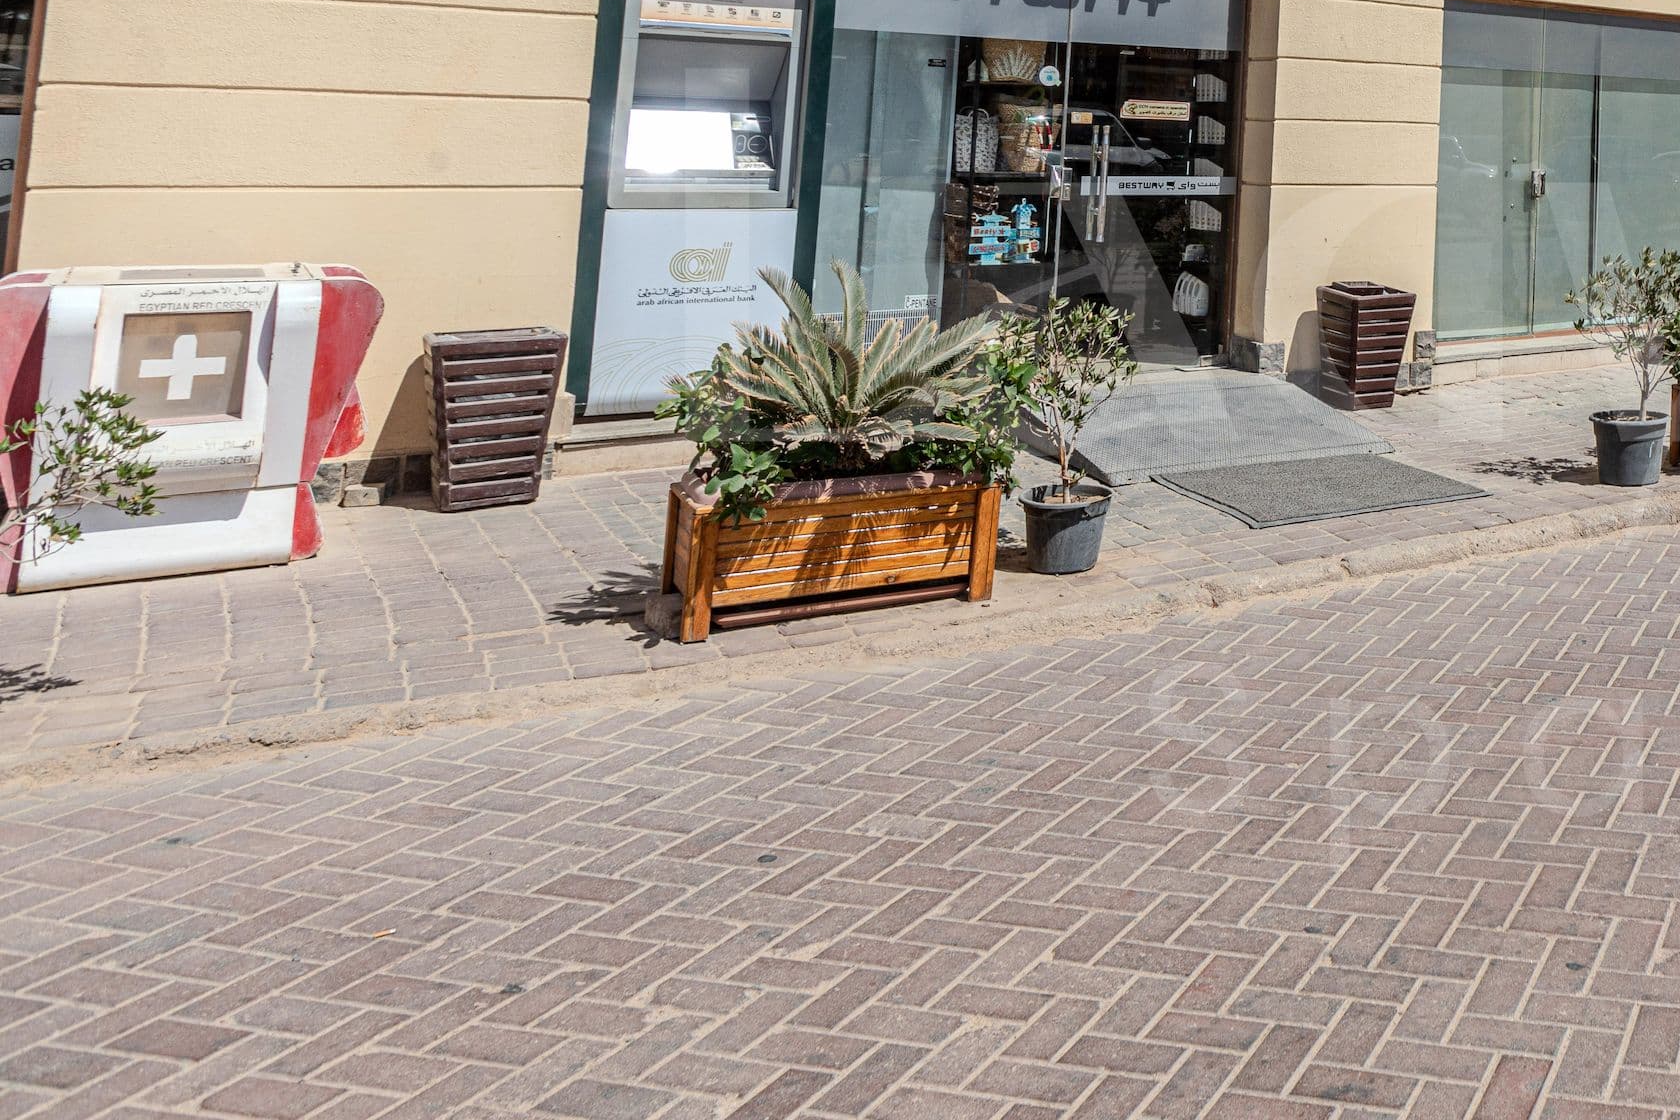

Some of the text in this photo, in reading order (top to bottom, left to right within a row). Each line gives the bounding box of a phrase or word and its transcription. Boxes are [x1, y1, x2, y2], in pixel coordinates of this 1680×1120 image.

[1118, 181, 1165, 190] BESTWAY
[636, 294, 756, 307] arab african international bank
[139, 301, 190, 313] EGYPTIAN
[192, 301, 213, 311] RED
